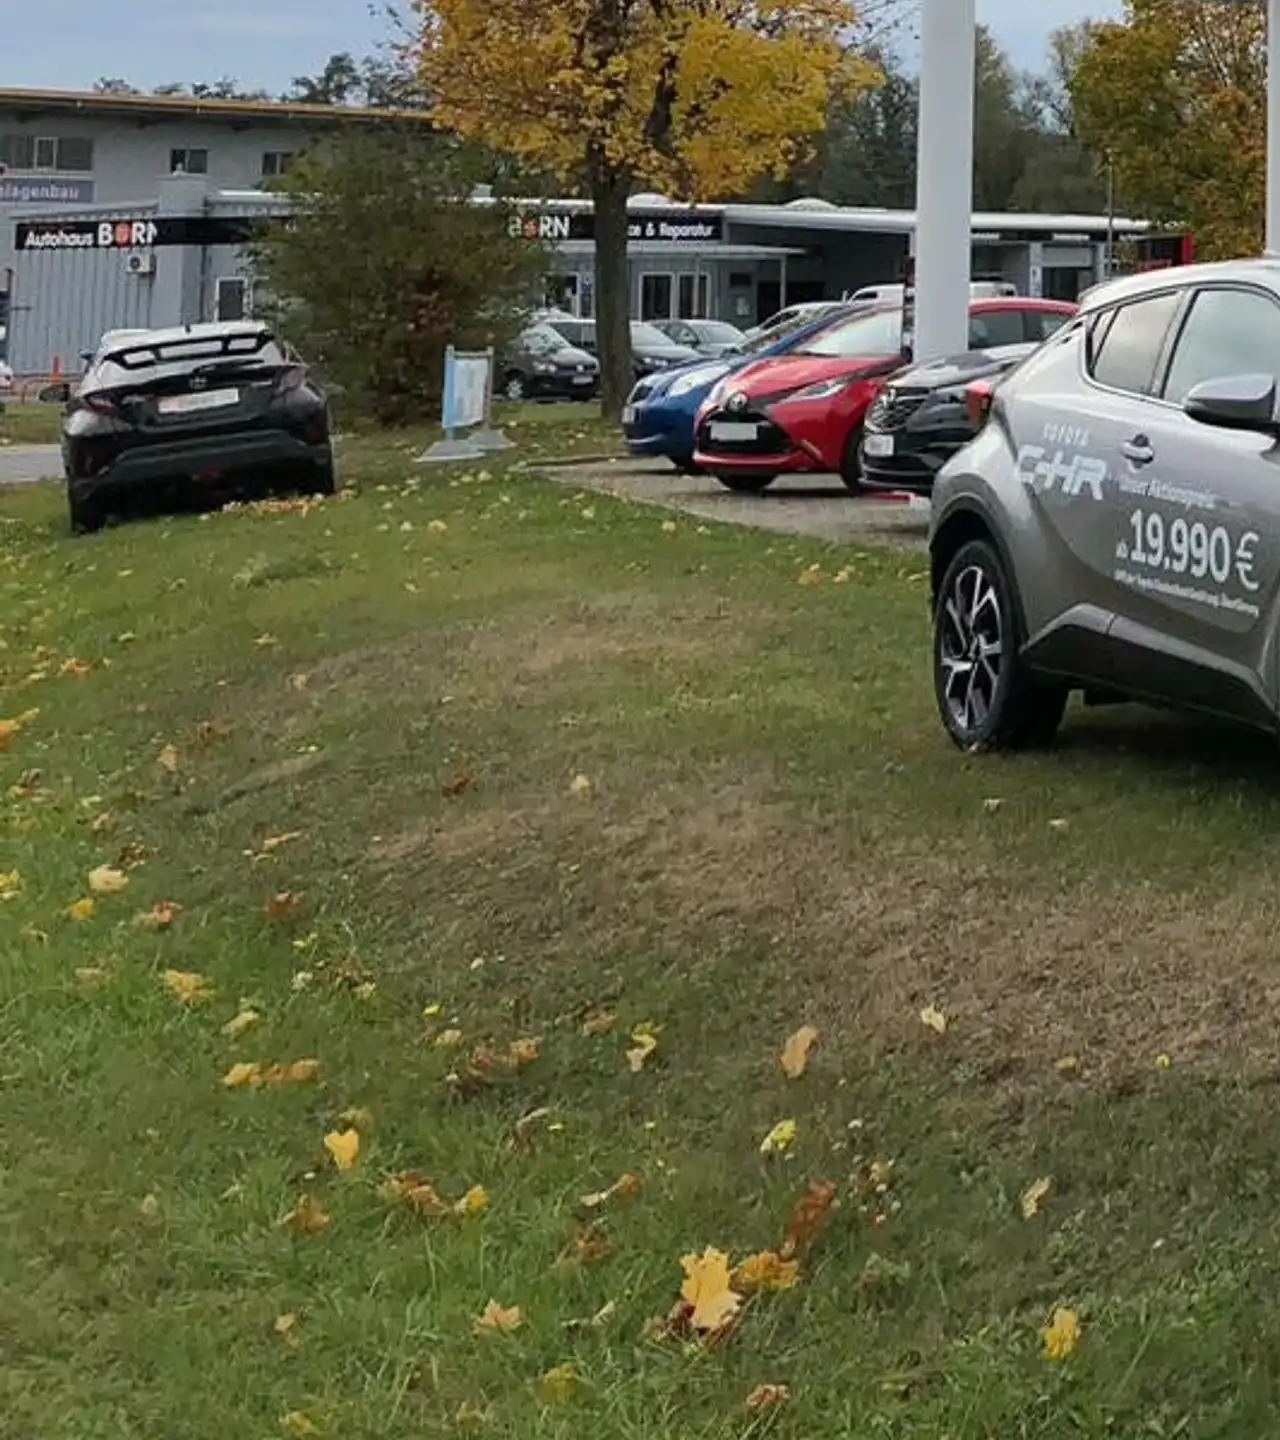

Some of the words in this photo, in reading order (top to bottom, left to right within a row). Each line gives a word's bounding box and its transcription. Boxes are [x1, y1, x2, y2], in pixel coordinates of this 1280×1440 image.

[25, 229, 95, 247] Autohaus
[659, 221, 714, 240] Reparatur
[1130, 508, 1230, 583] 19.990
[1235, 531, 1259, 591] €
